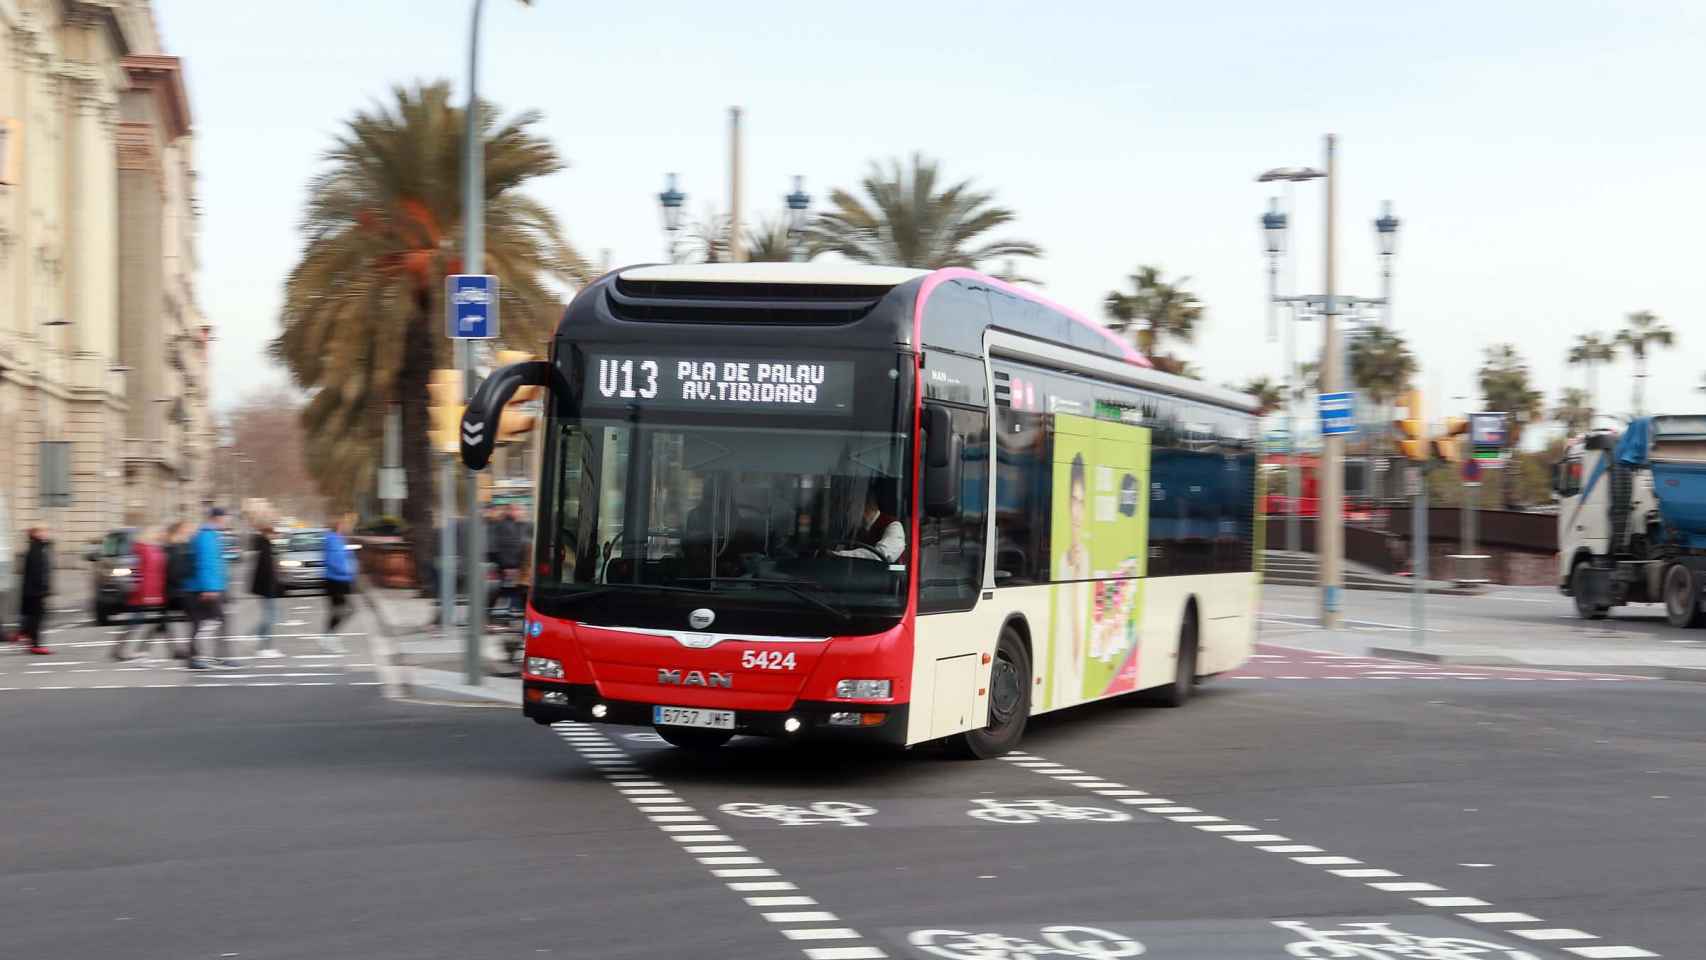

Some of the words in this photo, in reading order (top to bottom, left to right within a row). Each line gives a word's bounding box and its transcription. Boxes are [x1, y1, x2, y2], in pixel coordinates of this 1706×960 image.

[677, 361, 716, 381] PLA
[723, 362, 751, 382] DE
[757, 363, 825, 384] PALAU
[682, 380, 818, 404] AV.TIBIDABO
[741, 649, 797, 670] 5424
[657, 668, 734, 688] MAN
[663, 708, 700, 724] 6757
[703, 712, 731, 727] JWF
